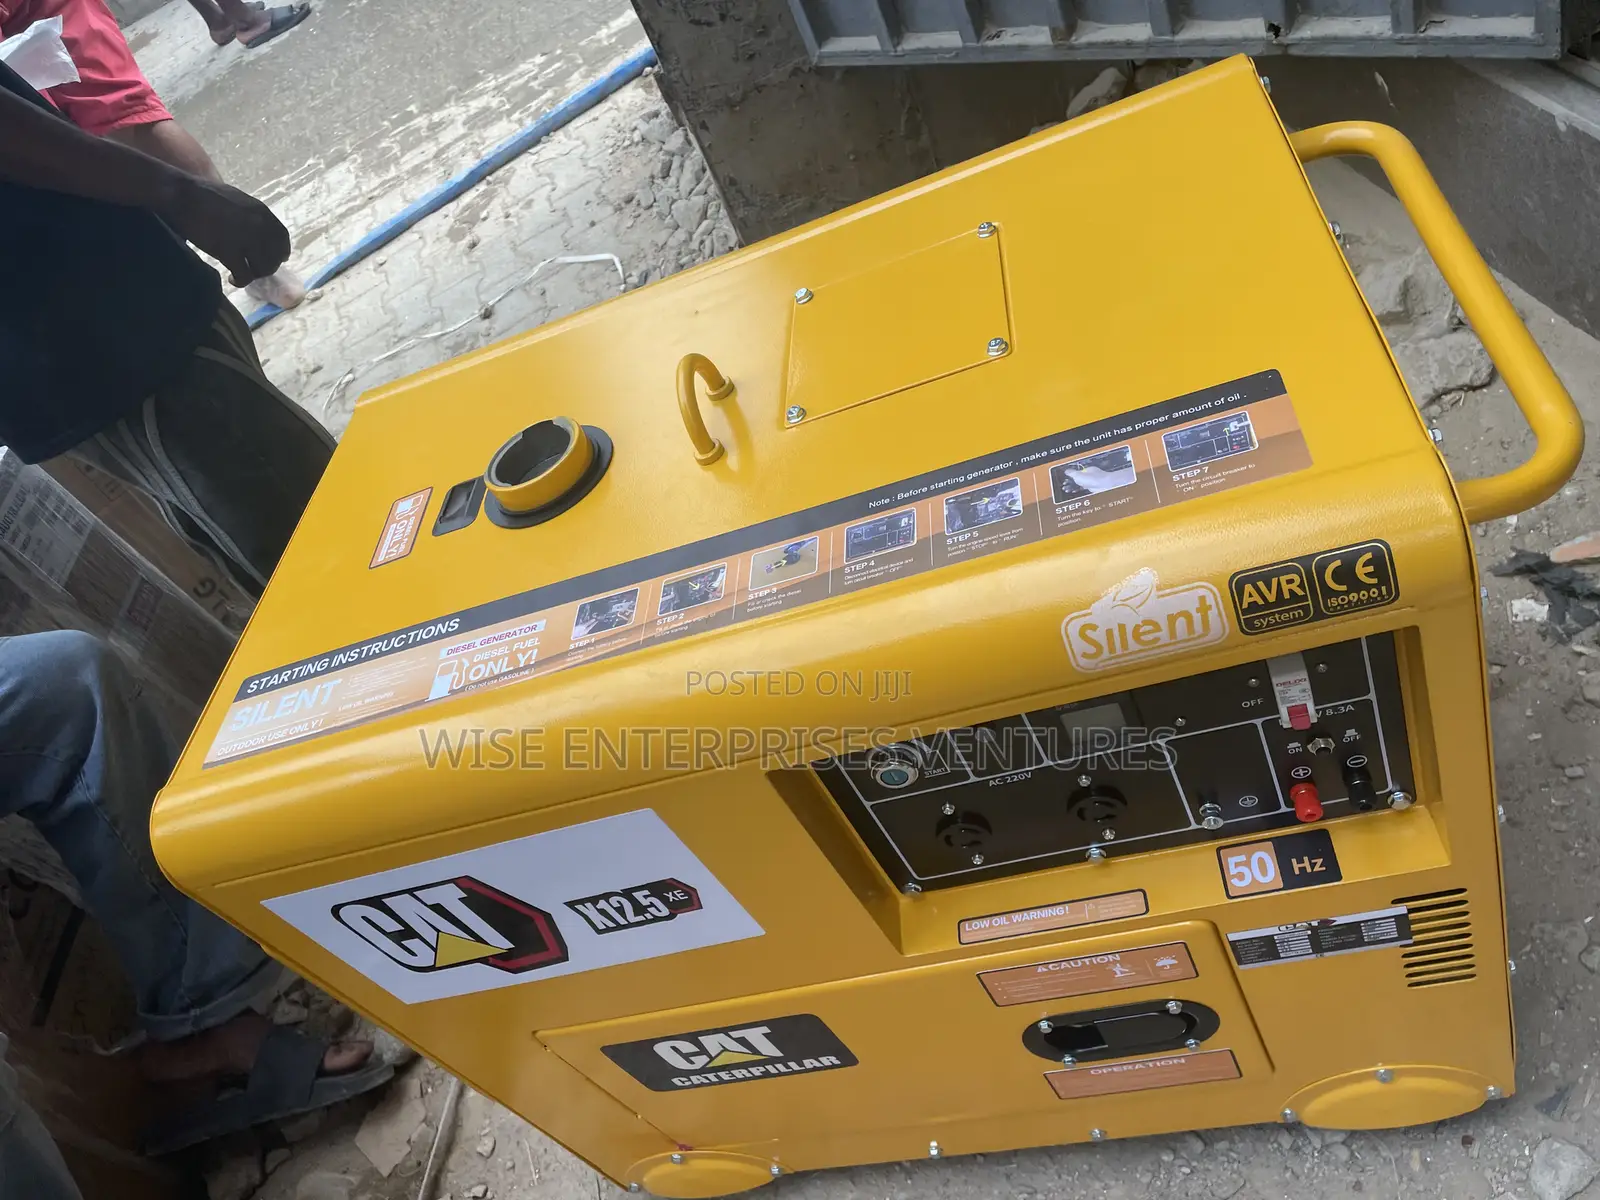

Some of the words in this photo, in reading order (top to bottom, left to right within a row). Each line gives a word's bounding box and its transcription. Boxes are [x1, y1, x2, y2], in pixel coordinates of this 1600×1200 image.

[868, 497, 890, 509] Note
[897, 486, 928, 500] Before
[929, 475, 965, 491] starting
[966, 461, 1013, 482] generator
[1020, 451, 1048, 464] make
[1049, 441, 1073, 454] sure
[1074, 436, 1091, 447] the
[1092, 430, 1112, 442] unit
[1113, 426, 1133, 436] has
[1134, 414, 1170, 431] proper
[1172, 400, 1213, 419] amount
[1214, 397, 1225, 406] of
[1227, 392, 1241, 403] oil
[1172, 469, 1200, 481] STEP
[1202, 473, 1221, 481] circuit
[1223, 466, 1246, 475] breaker
[1055, 503, 1081, 514] STEP
[946, 533, 970, 545] STEP
[844, 562, 867, 573] STEP
[1324, 552, 1379, 592] CE
[747, 590, 769, 600] STEP
[1241, 573, 1306, 609] AVR
[656, 615, 677, 625] STEP
[1077, 595, 1213, 661] Silent
[1253, 607, 1304, 629] system
[446, 640, 478, 656] DIESEL
[479, 624, 538, 647] GENERATOR
[473, 647, 511, 663] DIESEL
[512, 637, 541, 651] FUEL
[246, 657, 329, 693] STARTING
[330, 617, 461, 668] INSTRUCTIONS
[231, 678, 342, 732] SILENT
[1241, 698, 1264, 708] OFF
[1325, 704, 1355, 717] 8.3A
[216, 734, 268, 756] OUTDOOR
[267, 727, 287, 742] USE
[1342, 734, 1362, 743] OFF
[924, 767, 946, 776] START
[989, 777, 1004, 787] AC
[1006, 770, 1033, 784] 220V
[1227, 850, 1275, 888] 50
[1290, 855, 1327, 875] Hz
[663, 889, 689, 903] XE
[337, 882, 515, 967] CAT
[965, 919, 990, 932] LOW
[992, 916, 1010, 928] OIL
[1011, 905, 1070, 923] WARNING!
[1048, 953, 1121, 972] CAUTION
[652, 1025, 785, 1071] CAT
[671, 1055, 841, 1088] CATERPILLAR
[1090, 1057, 1186, 1076] OPERATION
